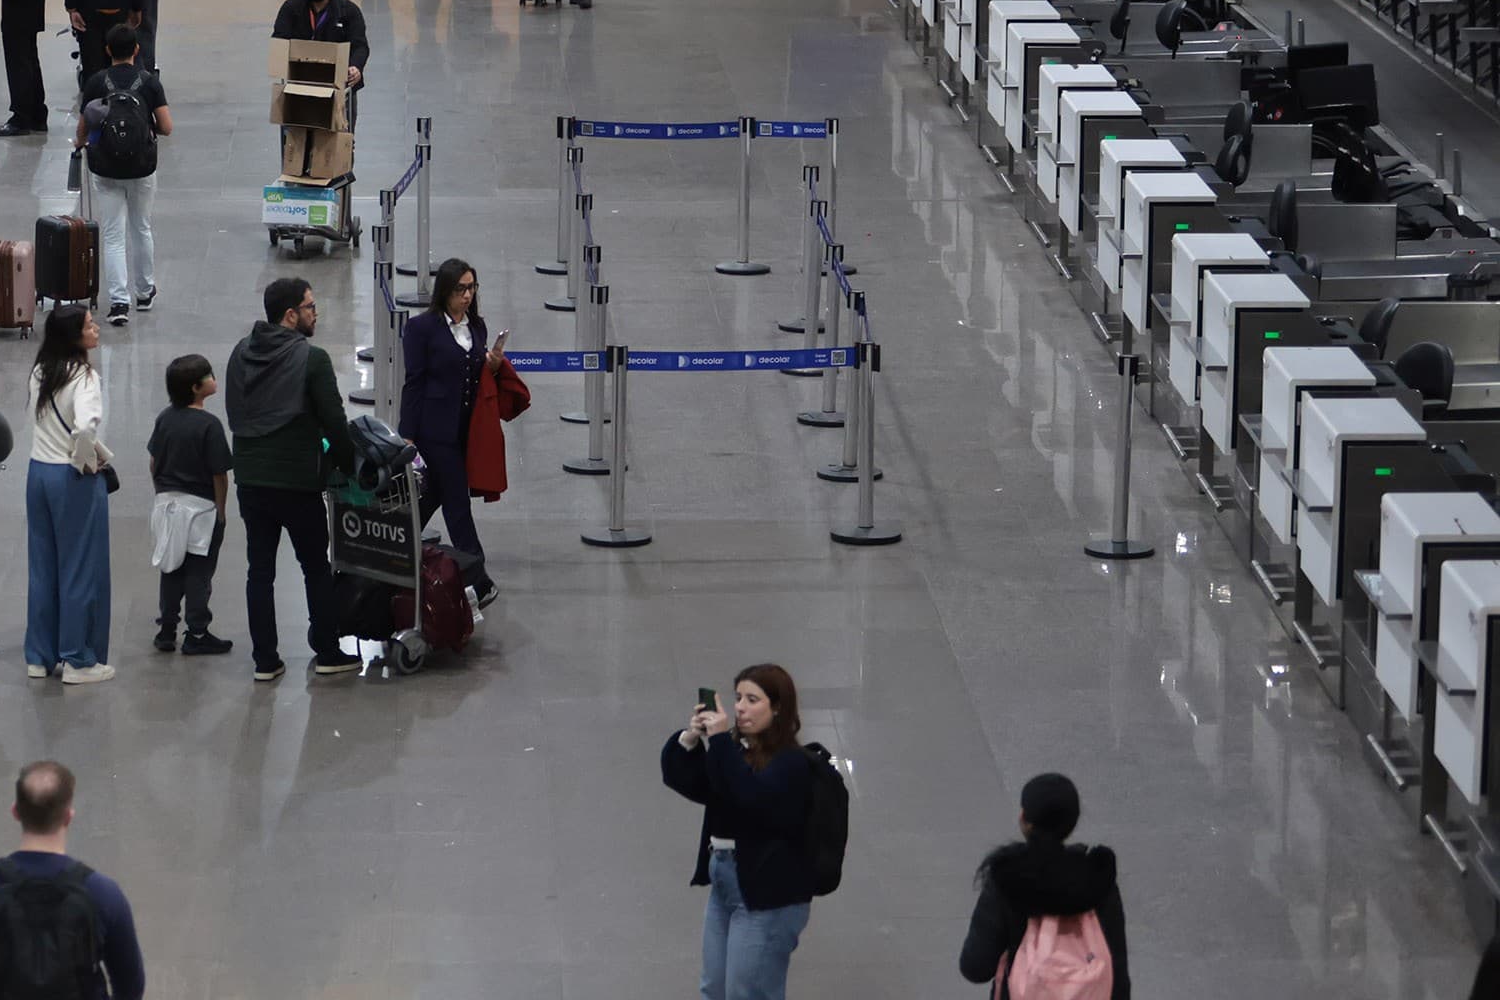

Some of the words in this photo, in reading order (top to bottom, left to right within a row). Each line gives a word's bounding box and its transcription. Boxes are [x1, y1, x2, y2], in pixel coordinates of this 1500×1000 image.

[510, 356, 543, 365] decolar
[627, 356, 657, 365] decolar
[691, 356, 724, 365] decolar
[758, 355, 790, 364] decolar
[364, 519, 406, 543] TOTVS
